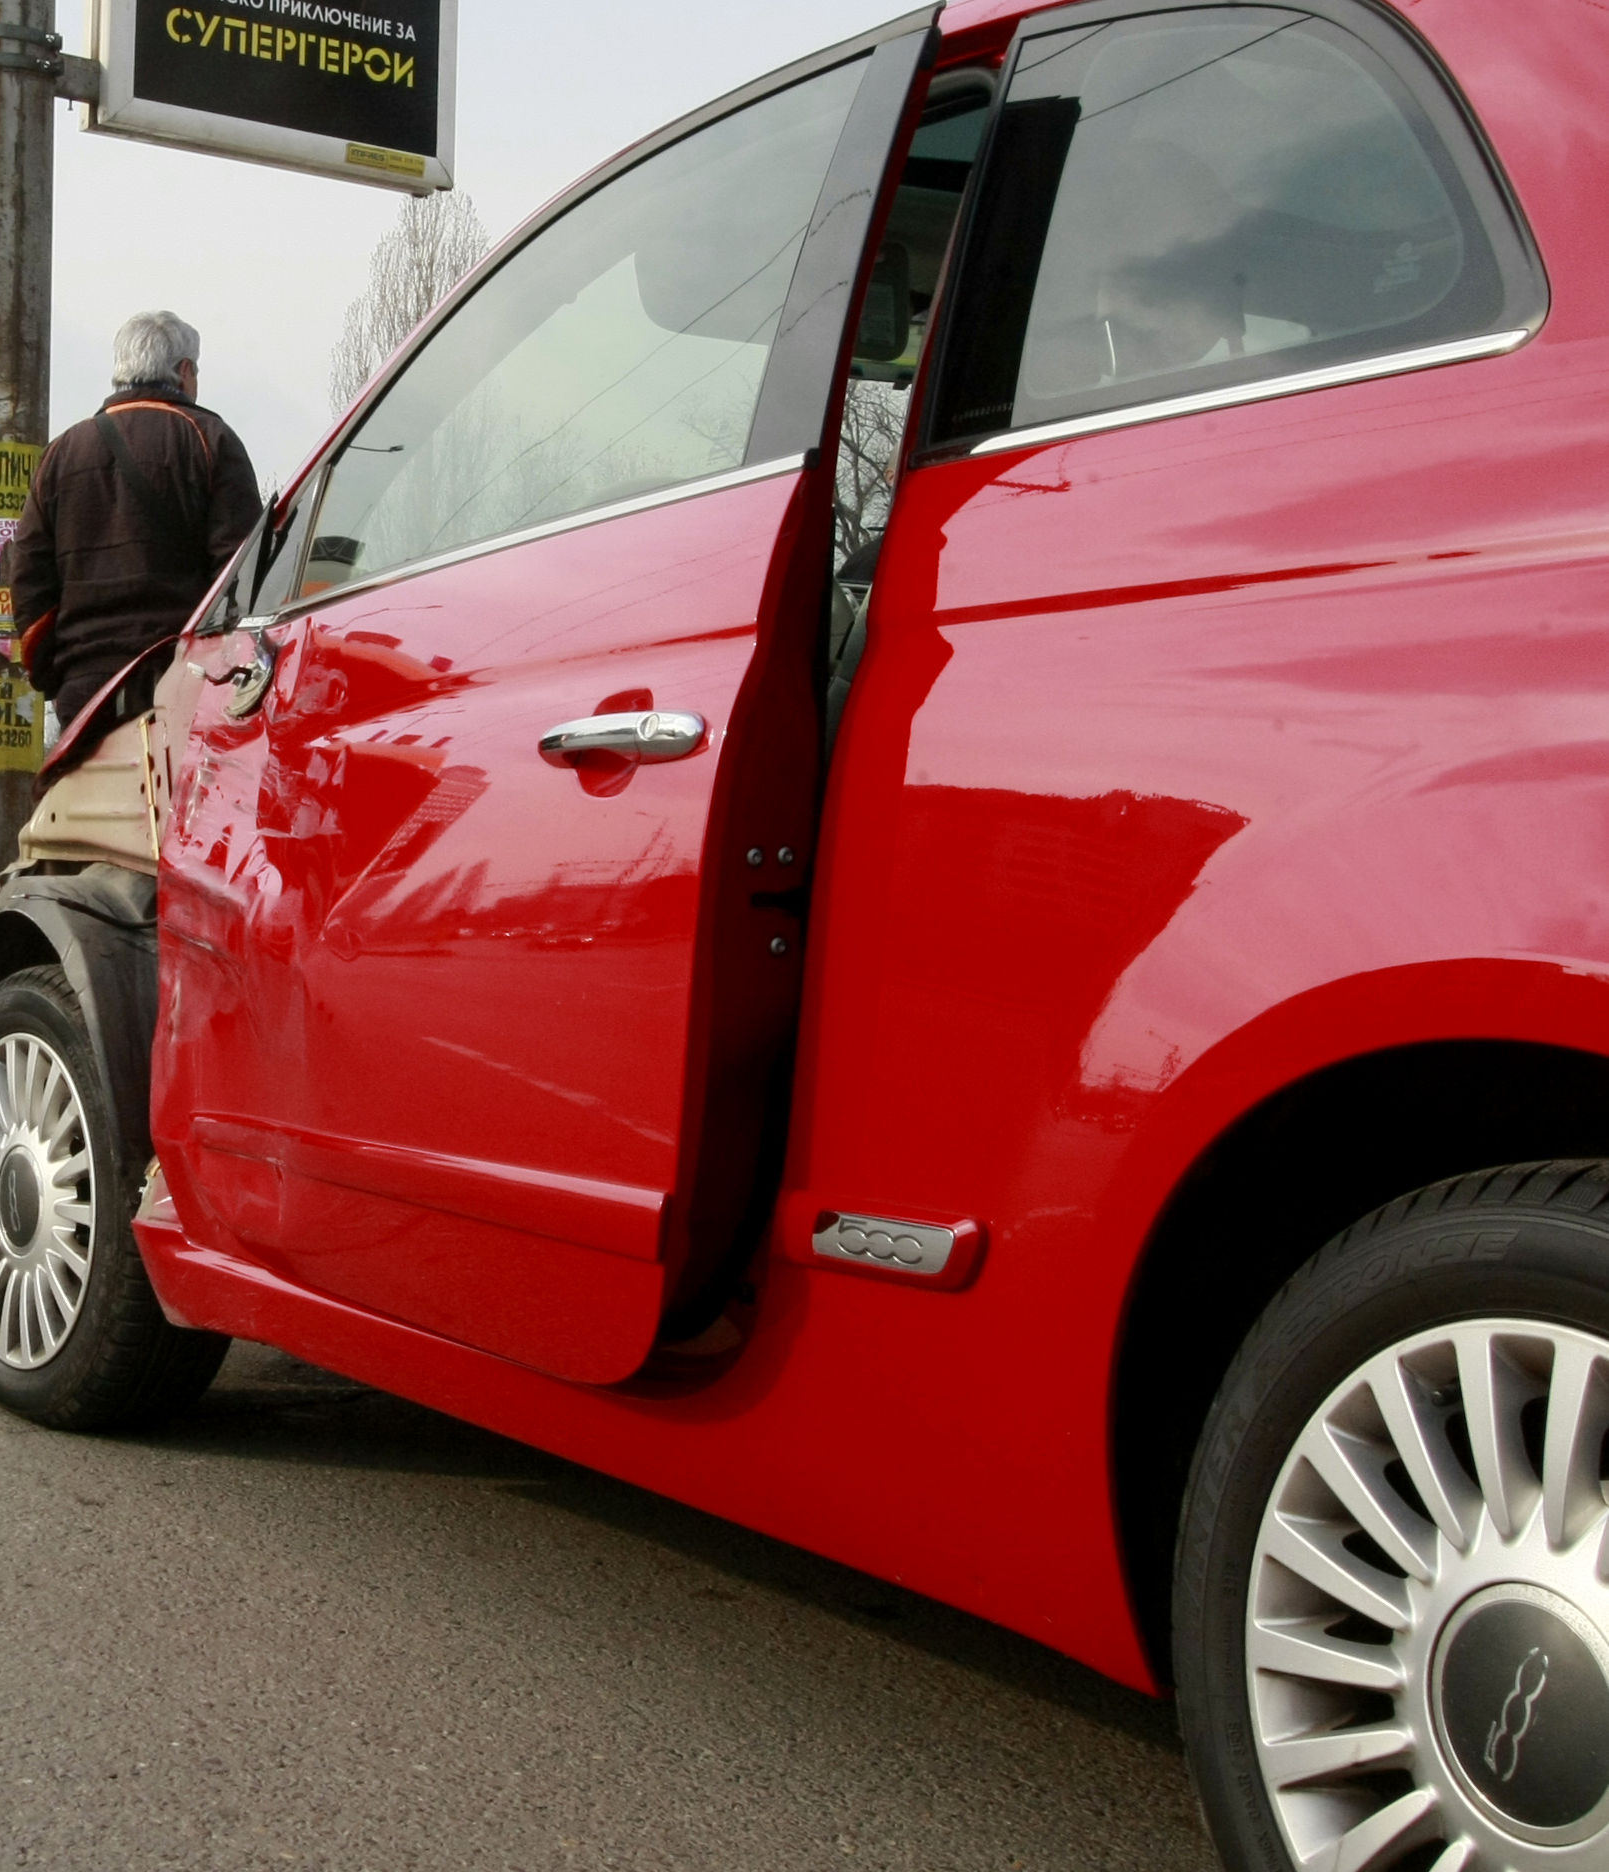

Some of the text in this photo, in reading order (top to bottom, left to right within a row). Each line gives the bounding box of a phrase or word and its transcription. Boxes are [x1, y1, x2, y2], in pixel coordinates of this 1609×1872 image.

[269, 0, 417, 42] ПРИКЛЮЧЕНИЕ ЗА
[166, 7, 414, 88] СУПЕРГЕРОИ
[837, 1217, 923, 1265] 500
